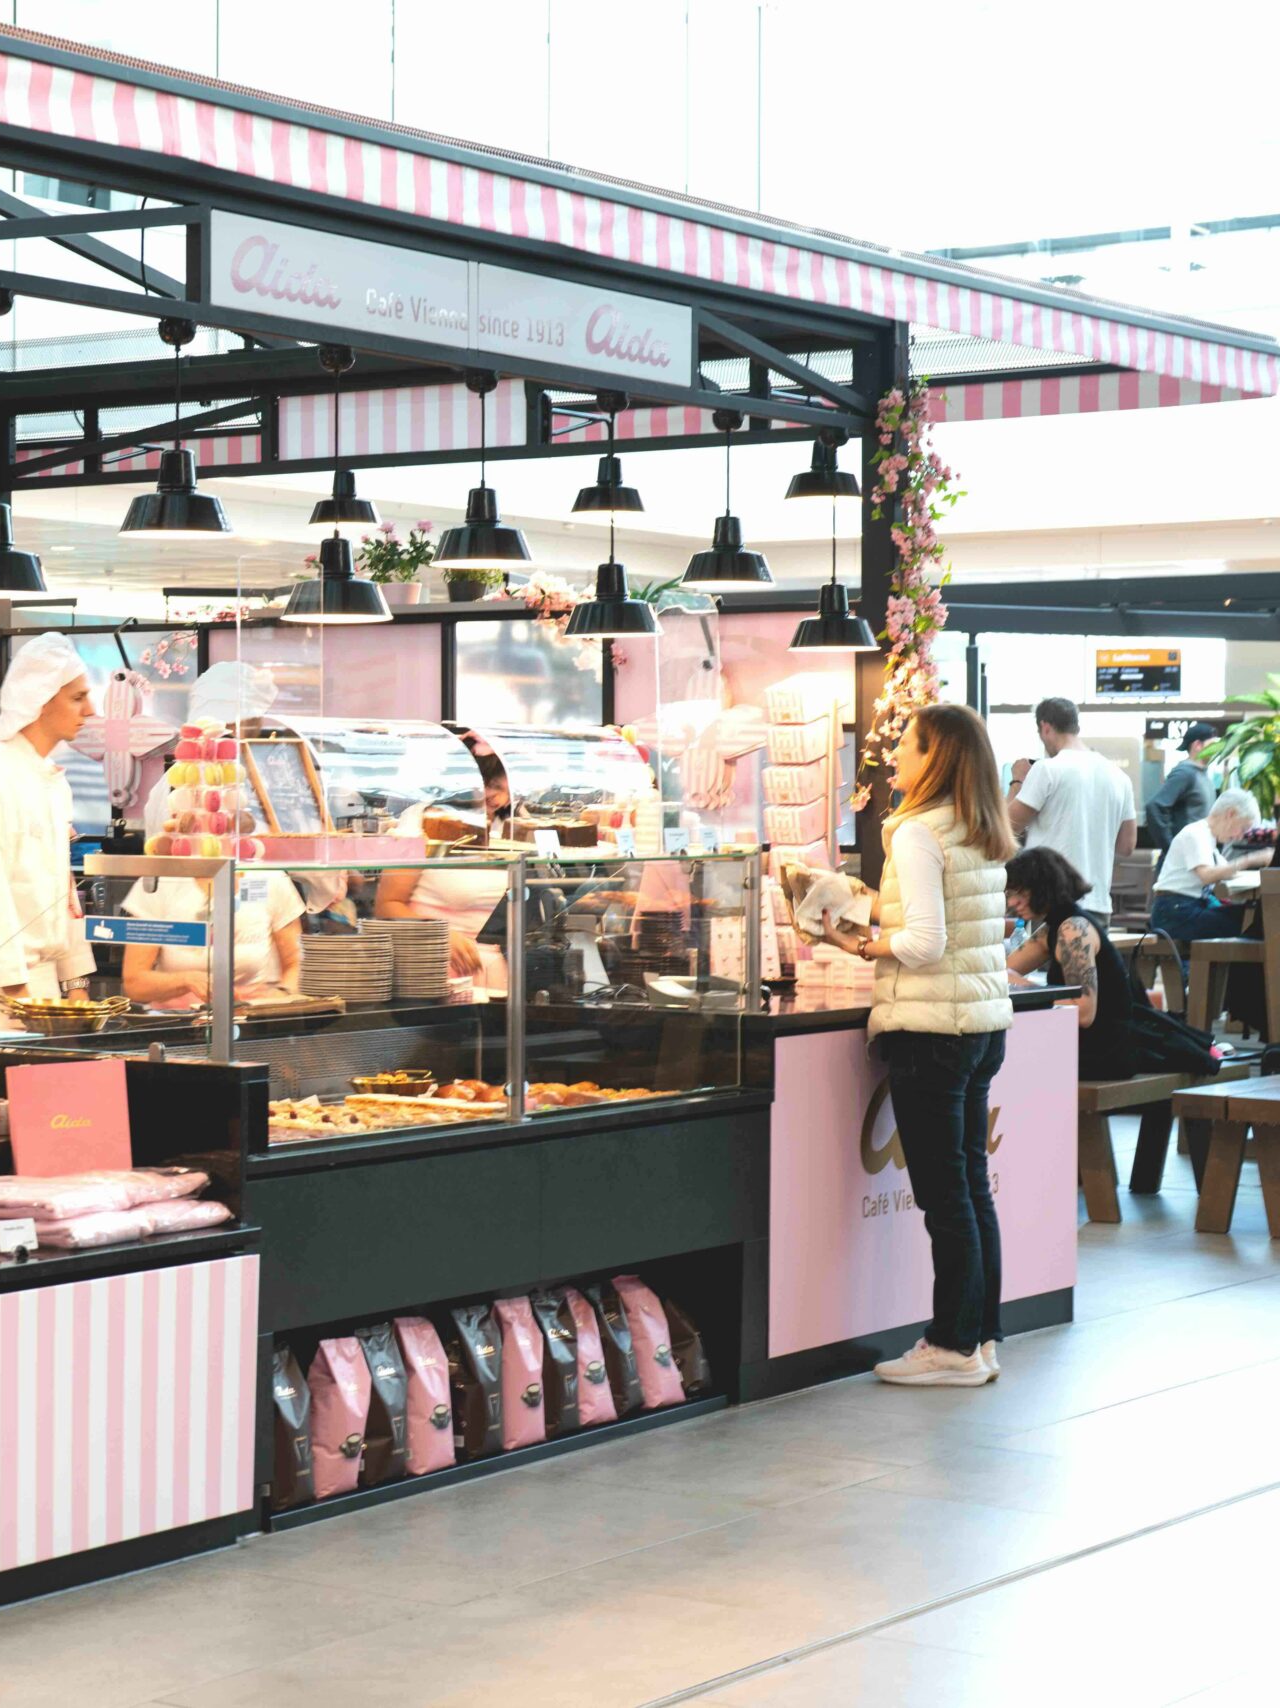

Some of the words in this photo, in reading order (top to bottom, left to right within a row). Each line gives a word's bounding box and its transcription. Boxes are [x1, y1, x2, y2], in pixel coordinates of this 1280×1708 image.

[479, 310, 519, 339] since
[527, 319, 564, 347] 1913
[862, 1193, 889, 1218] Café
